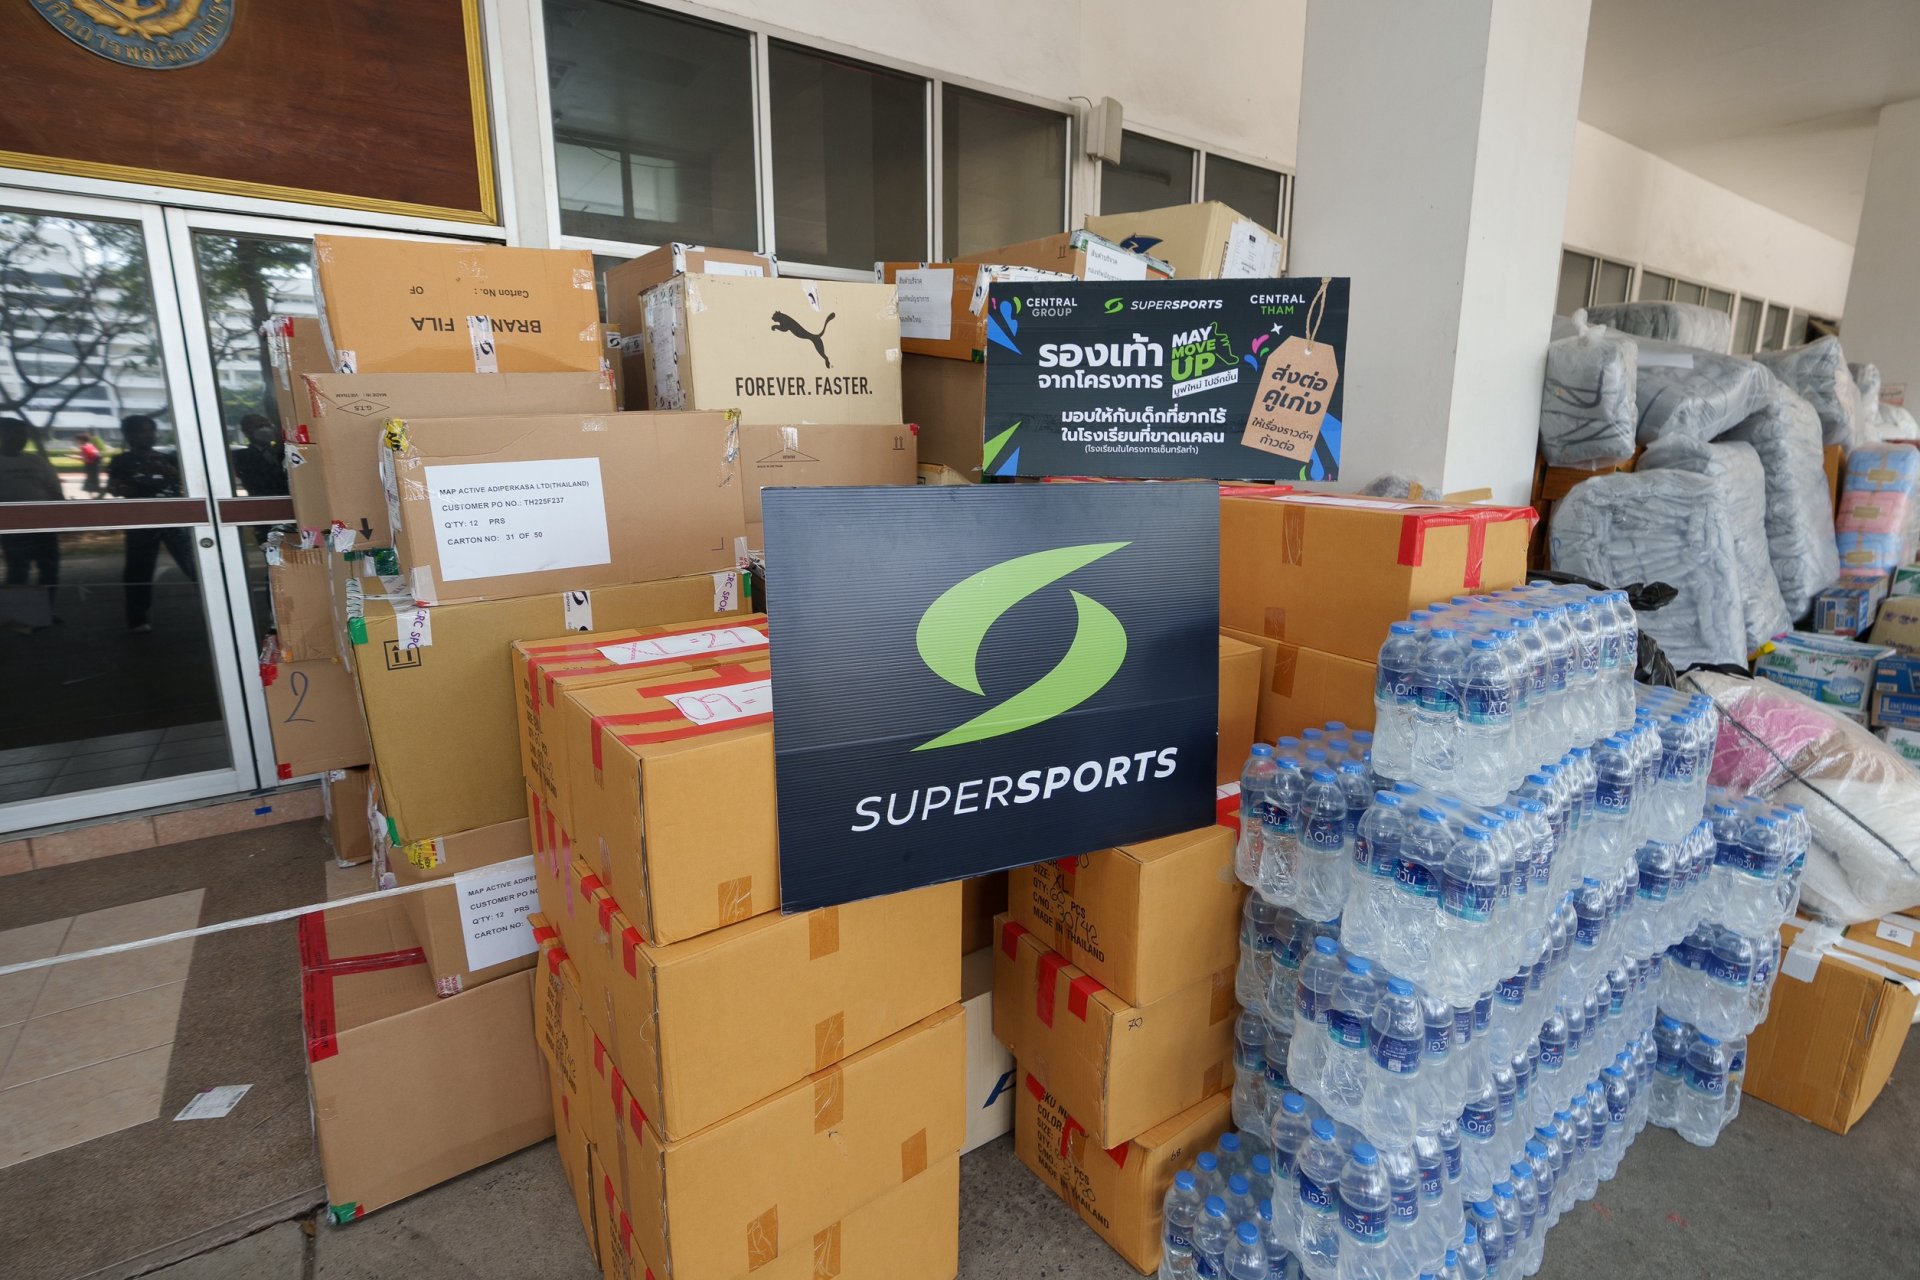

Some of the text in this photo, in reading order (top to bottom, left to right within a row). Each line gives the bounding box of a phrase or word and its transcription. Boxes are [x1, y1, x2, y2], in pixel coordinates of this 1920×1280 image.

[409, 286, 424, 295] OF
[498, 288, 529, 298] Carton
[1250, 294, 1306, 305] CENTRAL
[1026, 297, 1078, 308] CENTRAL
[1032, 307, 1072, 317] GROUP
[1130, 299, 1224, 311] SUPERSPORTS
[1260, 305, 1294, 315] THAM
[410, 317, 455, 332] FILA
[485, 318, 542, 333] BRAN
[1172, 325, 1213, 348] MAY
[1038, 332, 1164, 368] รองเท้า
[1171, 338, 1216, 361] MOVE
[1170, 352, 1216, 382] UP
[735, 375, 873, 397] FOREVER. FASTER.
[1037, 369, 1164, 390] จากโครงการ
[1271, 363, 1329, 392] ส่งต่อ
[1262, 385, 1322, 415] คู่เก่ง
[1061, 403, 1228, 424] มอบให้กับเด็กที่ยากไร้
[1061, 424, 1225, 443] ในโรงเรียนที่ขาดแคลน
[1251, 417, 1314, 441] ให้เรื่องราวดีๆ
[1259, 434, 1296, 452] ก้าวต่อ
[439, 480, 590, 496] MAP ACTIVE ADIPERKASA LTD(THAILAND)
[442, 502, 490, 512] CUSTOMER
[491, 501, 503, 509] PO
[523, 497, 564, 506] TH225F237
[488, 517, 506, 525] PRS
[447, 531, 543, 546] CARTON NO: 31 OF 50
[283, 671, 317, 724] 2
[851, 747, 1178, 832] SUPERSPORTS
[1314, 831, 1340, 843] One
[468, 888, 485, 897] MAP
[485, 881, 512, 893] ACTIVE
[1033, 877, 1050, 895] QTY:
[1070, 901, 1086, 920] PCS
[470, 894, 515, 911] CUSTOMER
[516, 891, 528, 899] PO
[495, 911, 504, 919] 12
[513, 904, 531, 914] PRS
[474, 921, 525, 940] CARTON NO:
[1033, 906, 1105, 963] MADE IN THAILAND
[1128, 1016, 1143, 1031] 70
[1037, 1116, 1053, 1140] SIZE:
[1467, 1120, 1492, 1133] One
[1074, 1165, 1090, 1186] PCS
[1038, 1154, 1057, 1180] MADE
[1071, 1187, 1110, 1229] THAILAND
